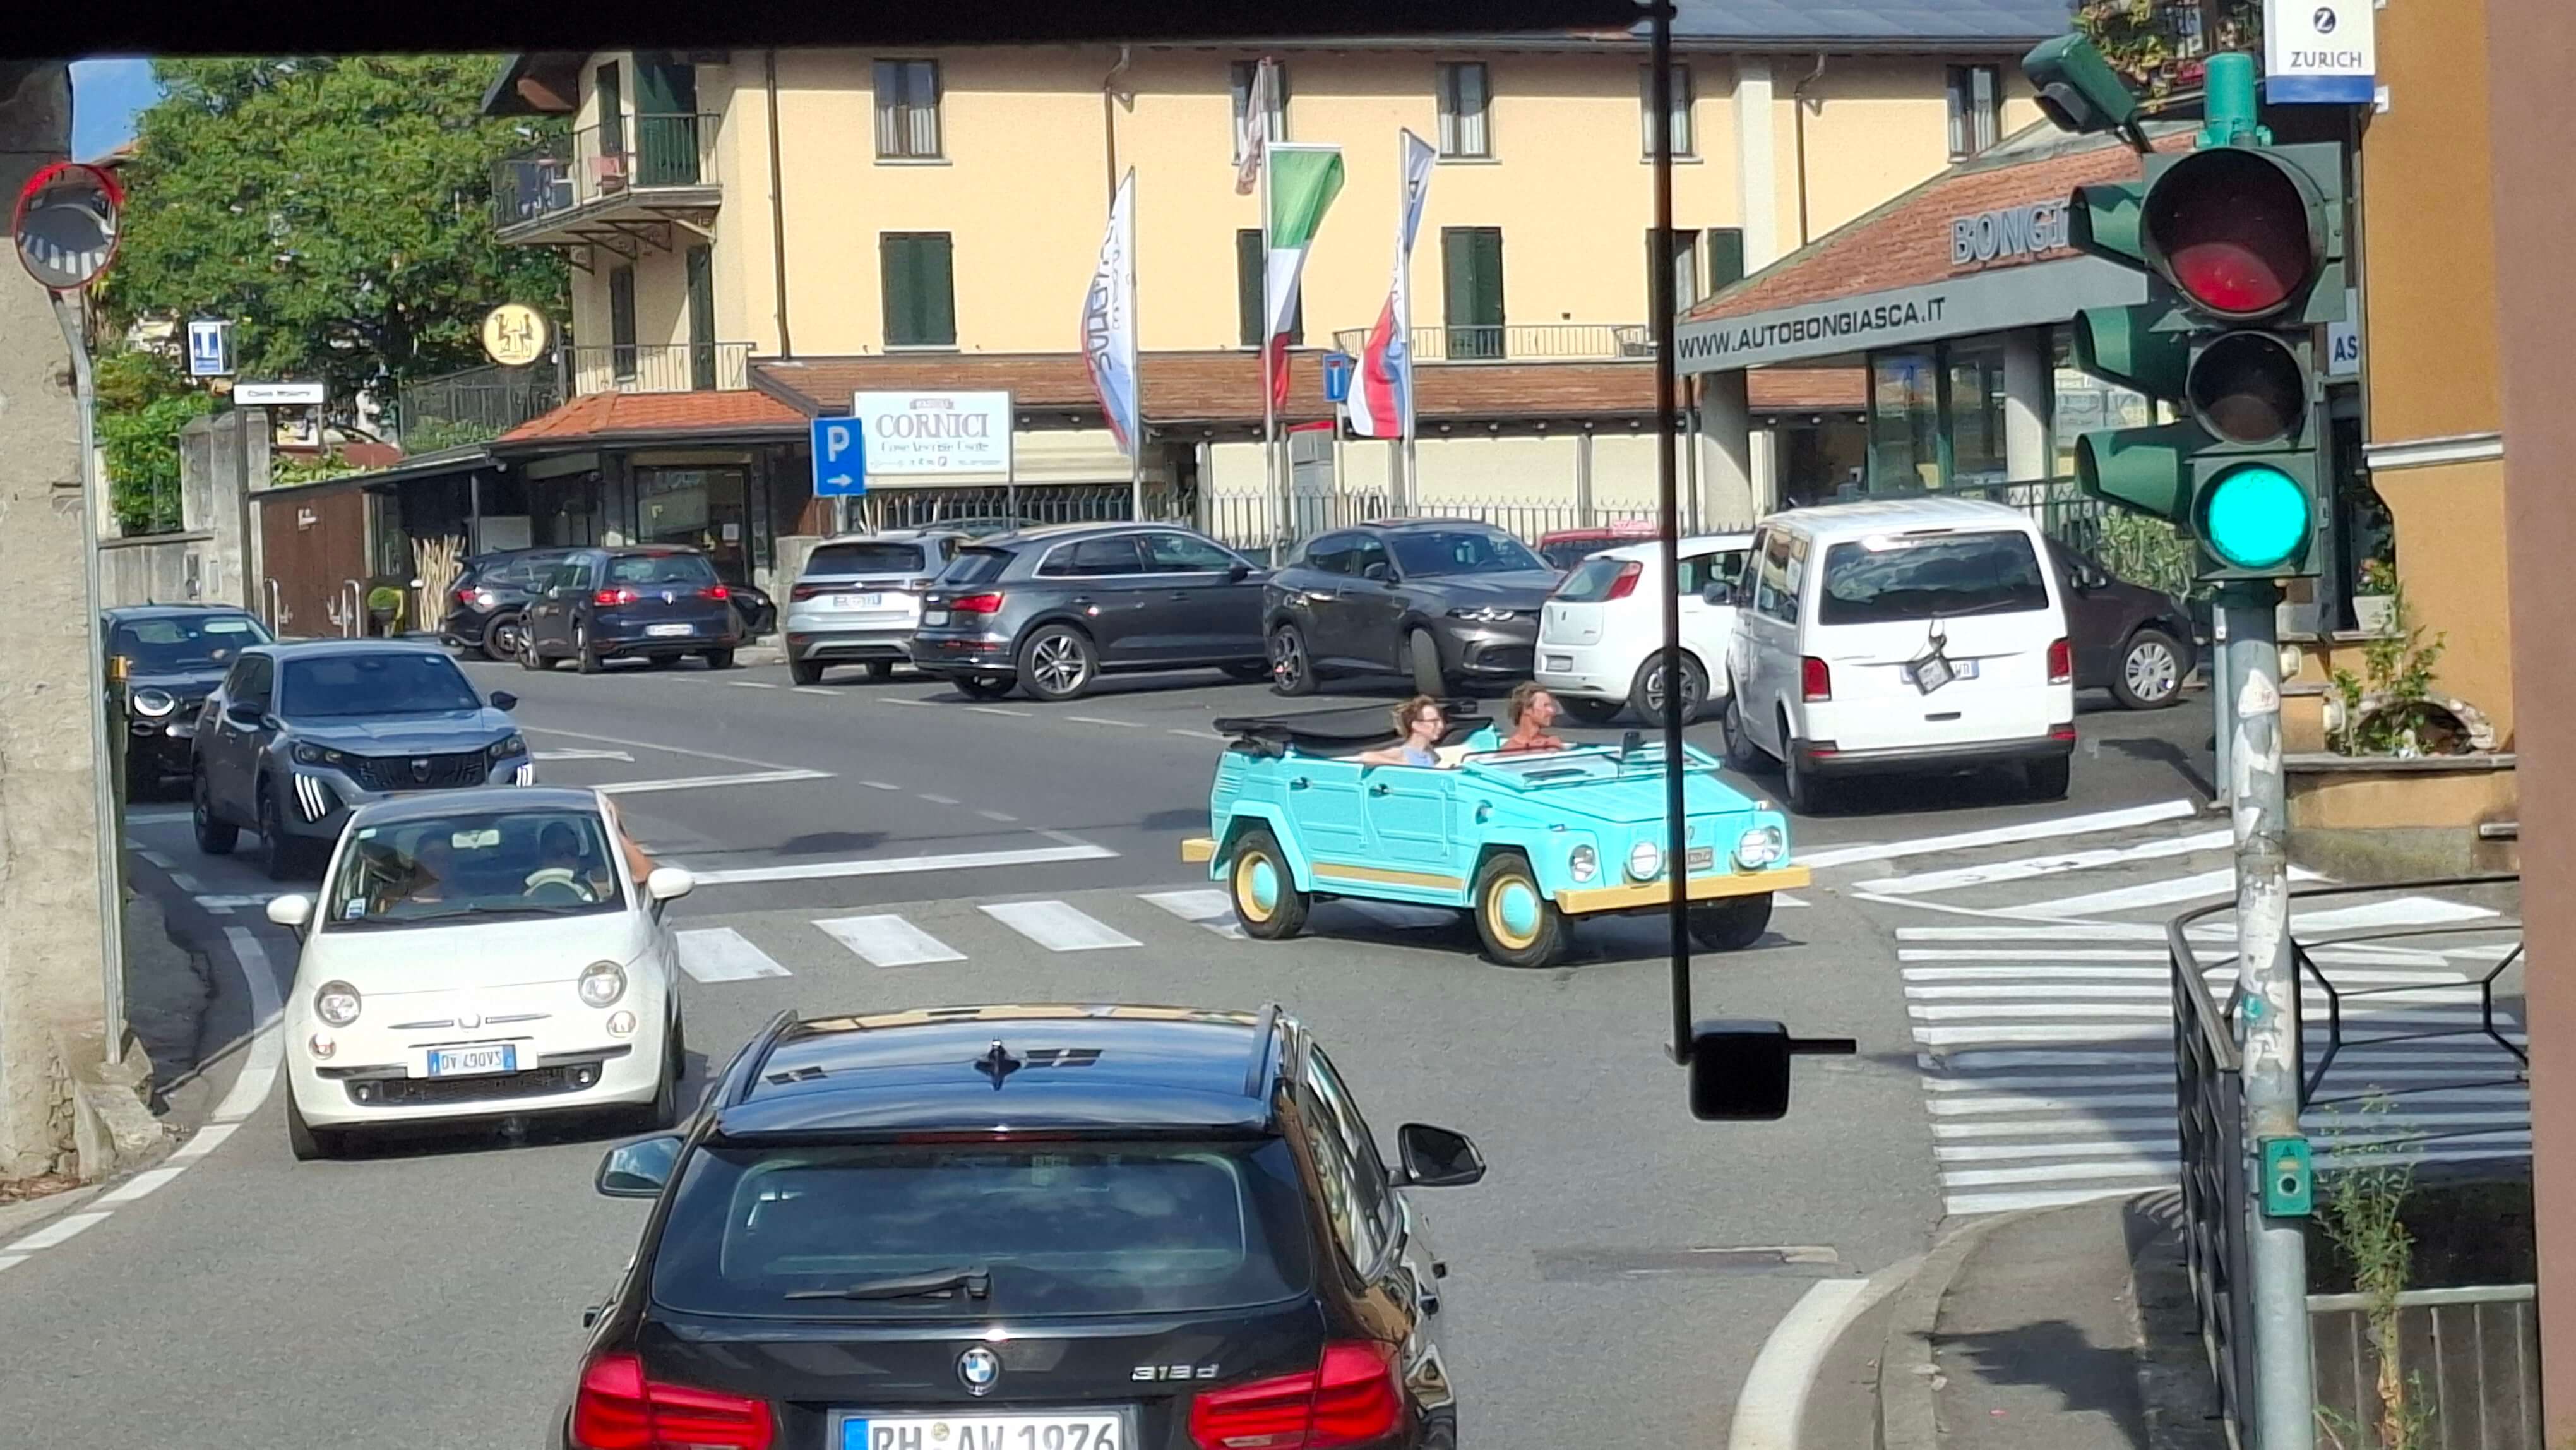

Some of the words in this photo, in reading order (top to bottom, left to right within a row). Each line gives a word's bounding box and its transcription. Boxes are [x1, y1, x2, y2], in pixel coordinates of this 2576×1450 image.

[2290, 51, 2362, 68] ZURICH
[1951, 198, 2072, 265] BONGI
[1678, 297, 1946, 359] WWW.AUTOBONGIASCA.IT
[875, 413, 990, 439] CORNICI
[827, 425, 850, 462] P
[873, 1426, 922, 1450] RH
[1018, 1423, 1115, 1450] 1976
